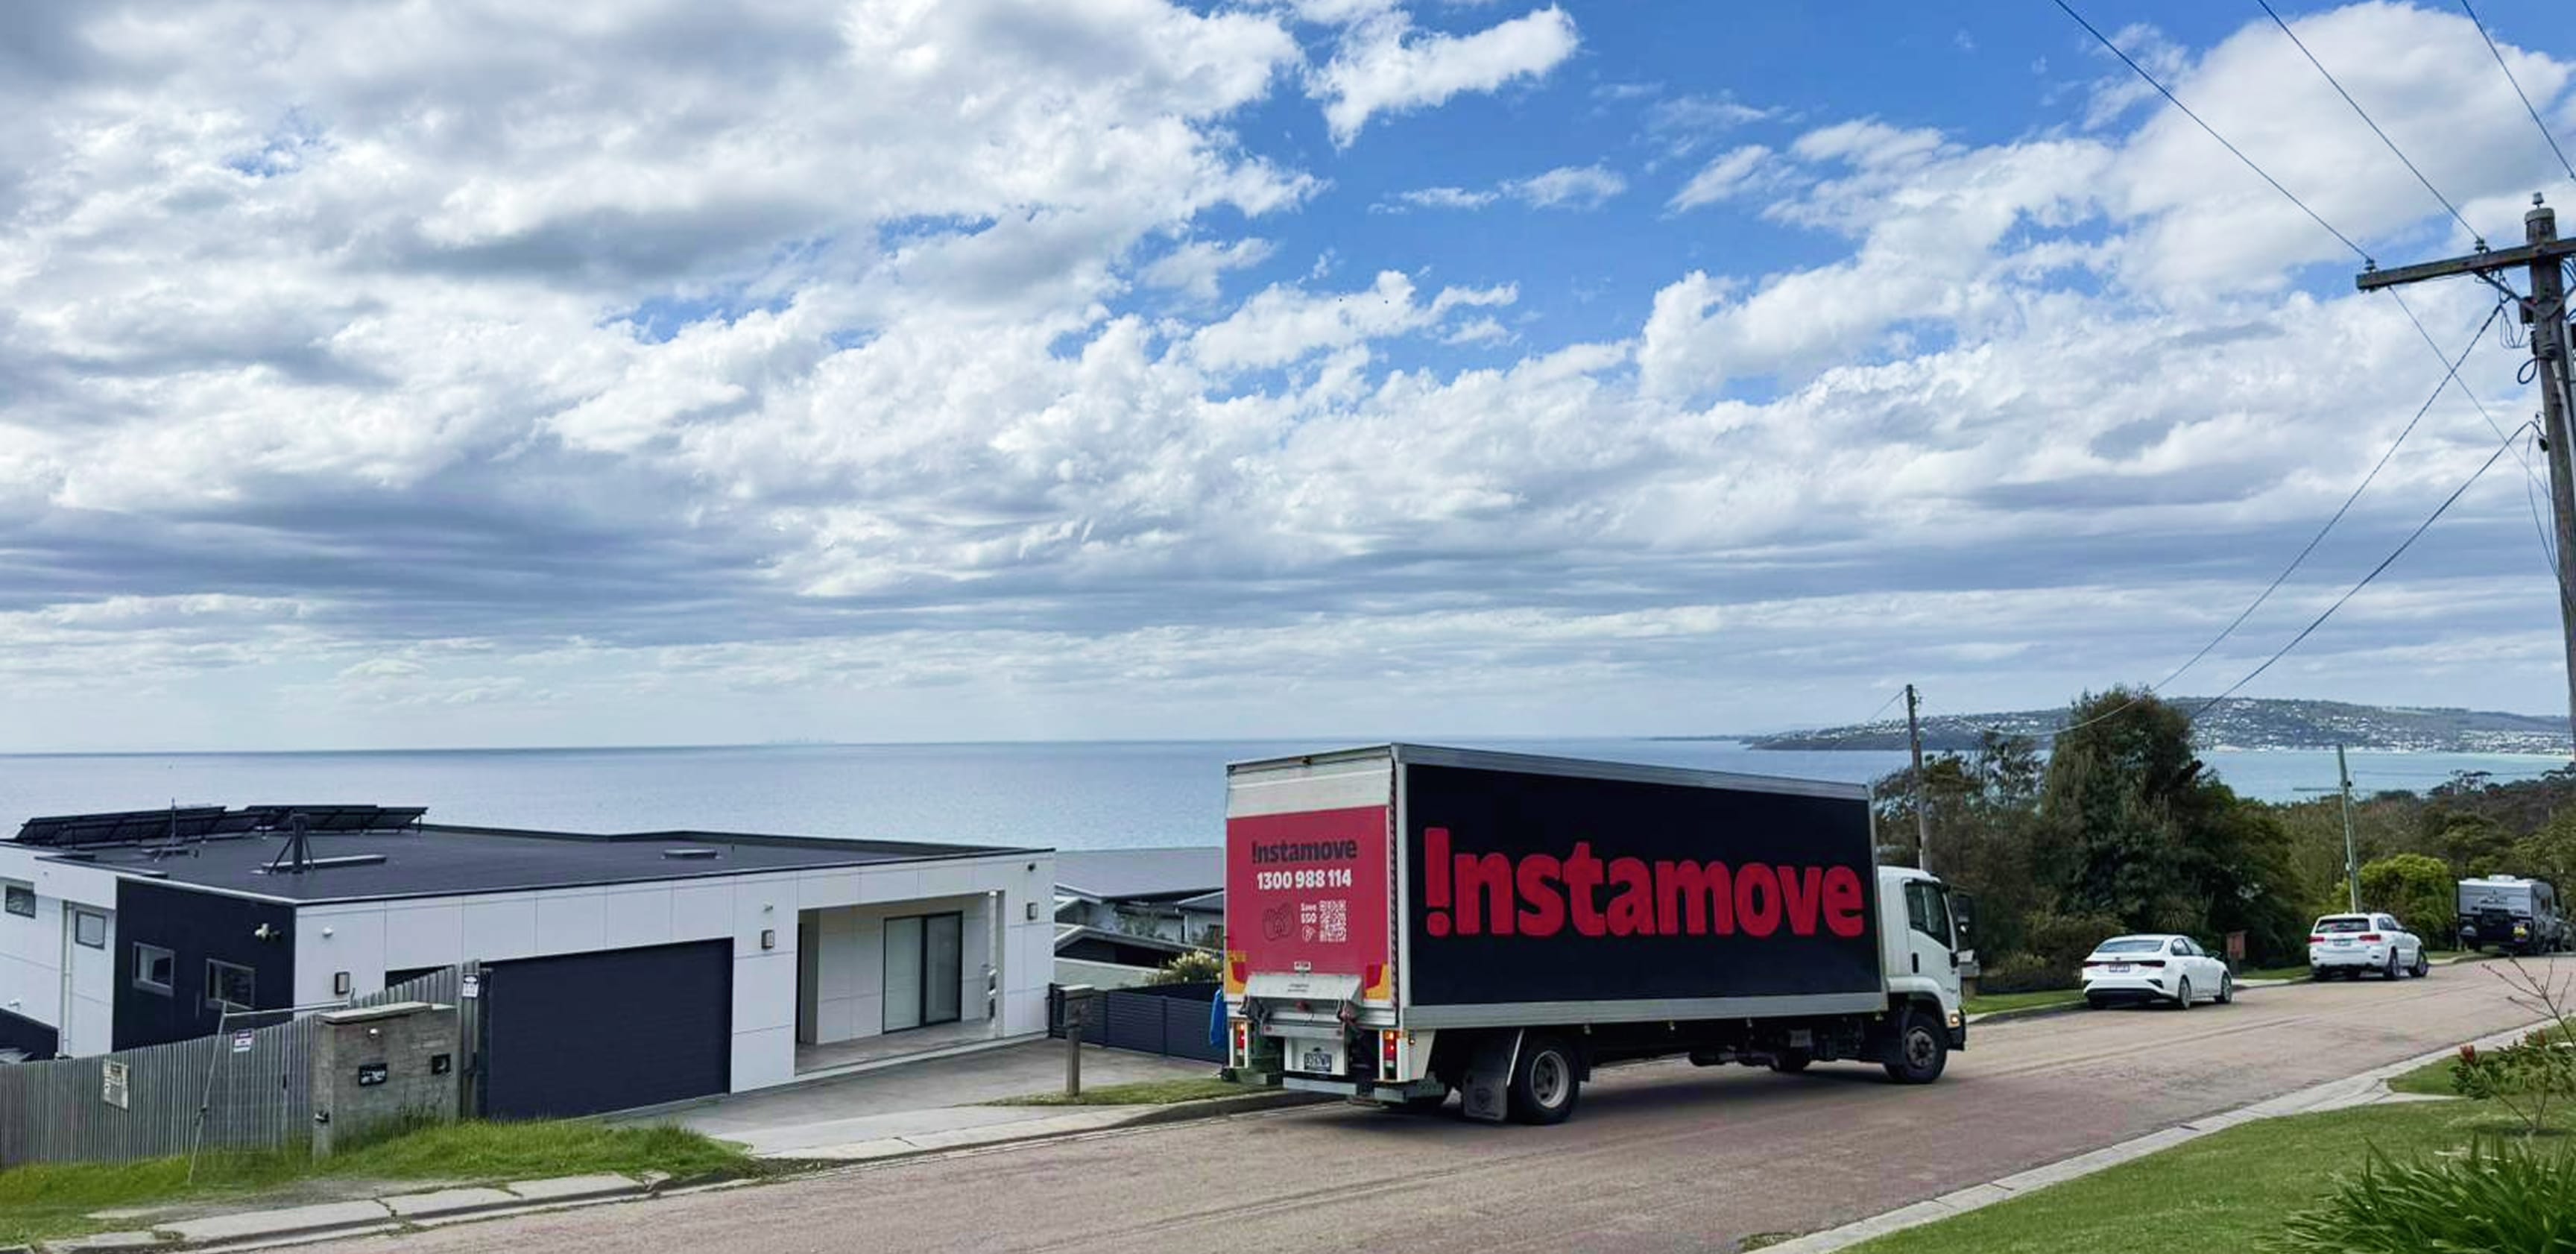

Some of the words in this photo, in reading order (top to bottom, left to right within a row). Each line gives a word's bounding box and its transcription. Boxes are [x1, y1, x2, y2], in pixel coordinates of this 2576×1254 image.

[1257, 872, 1292, 889] 1300
[1295, 870, 1326, 888] 988
[1328, 869, 1352, 887] 114
